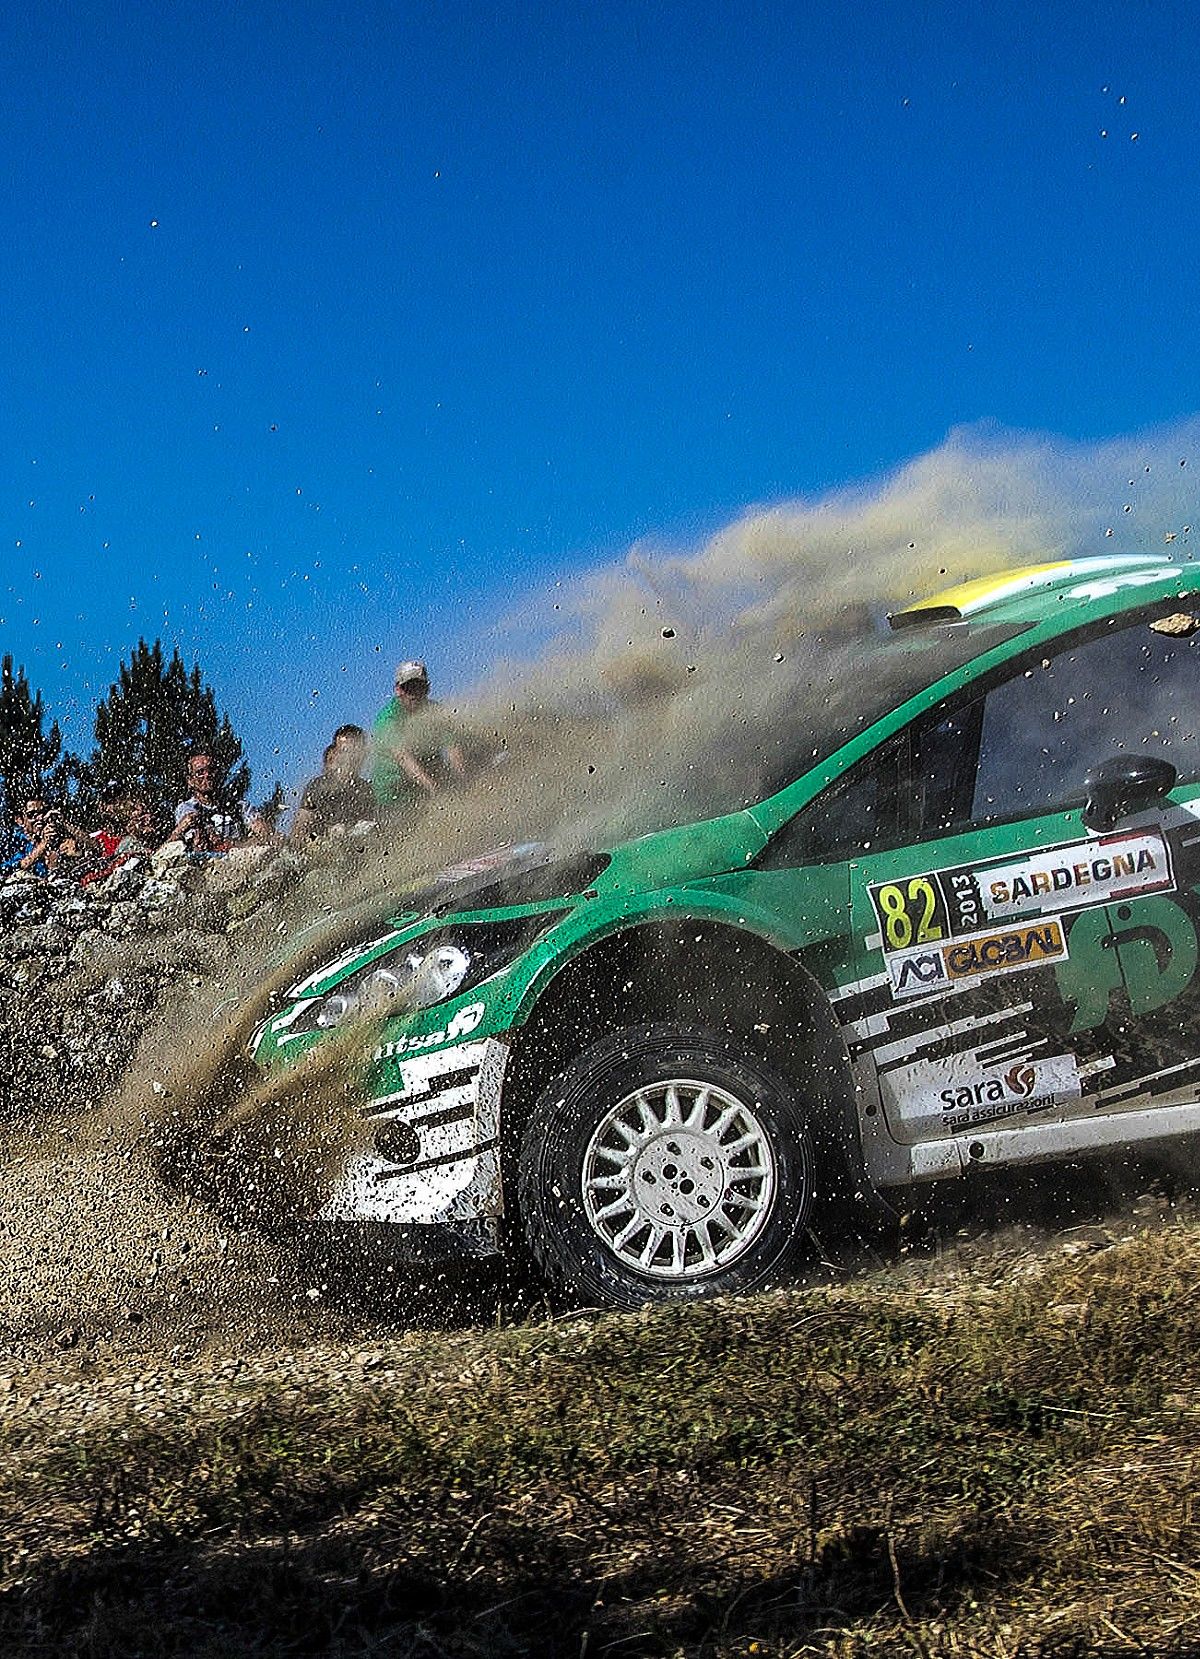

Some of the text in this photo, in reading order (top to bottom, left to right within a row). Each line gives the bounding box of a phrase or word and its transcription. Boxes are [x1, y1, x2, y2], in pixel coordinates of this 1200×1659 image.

[951, 872, 978, 927] 2013
[989, 847, 1158, 905] SARDEGNA
[878, 877, 944, 950] 82
[894, 926, 1064, 993] ACI GLOBAL
[940, 1079, 1005, 1111] sara
[941, 1092, 1056, 1127] sara assicurazioni
